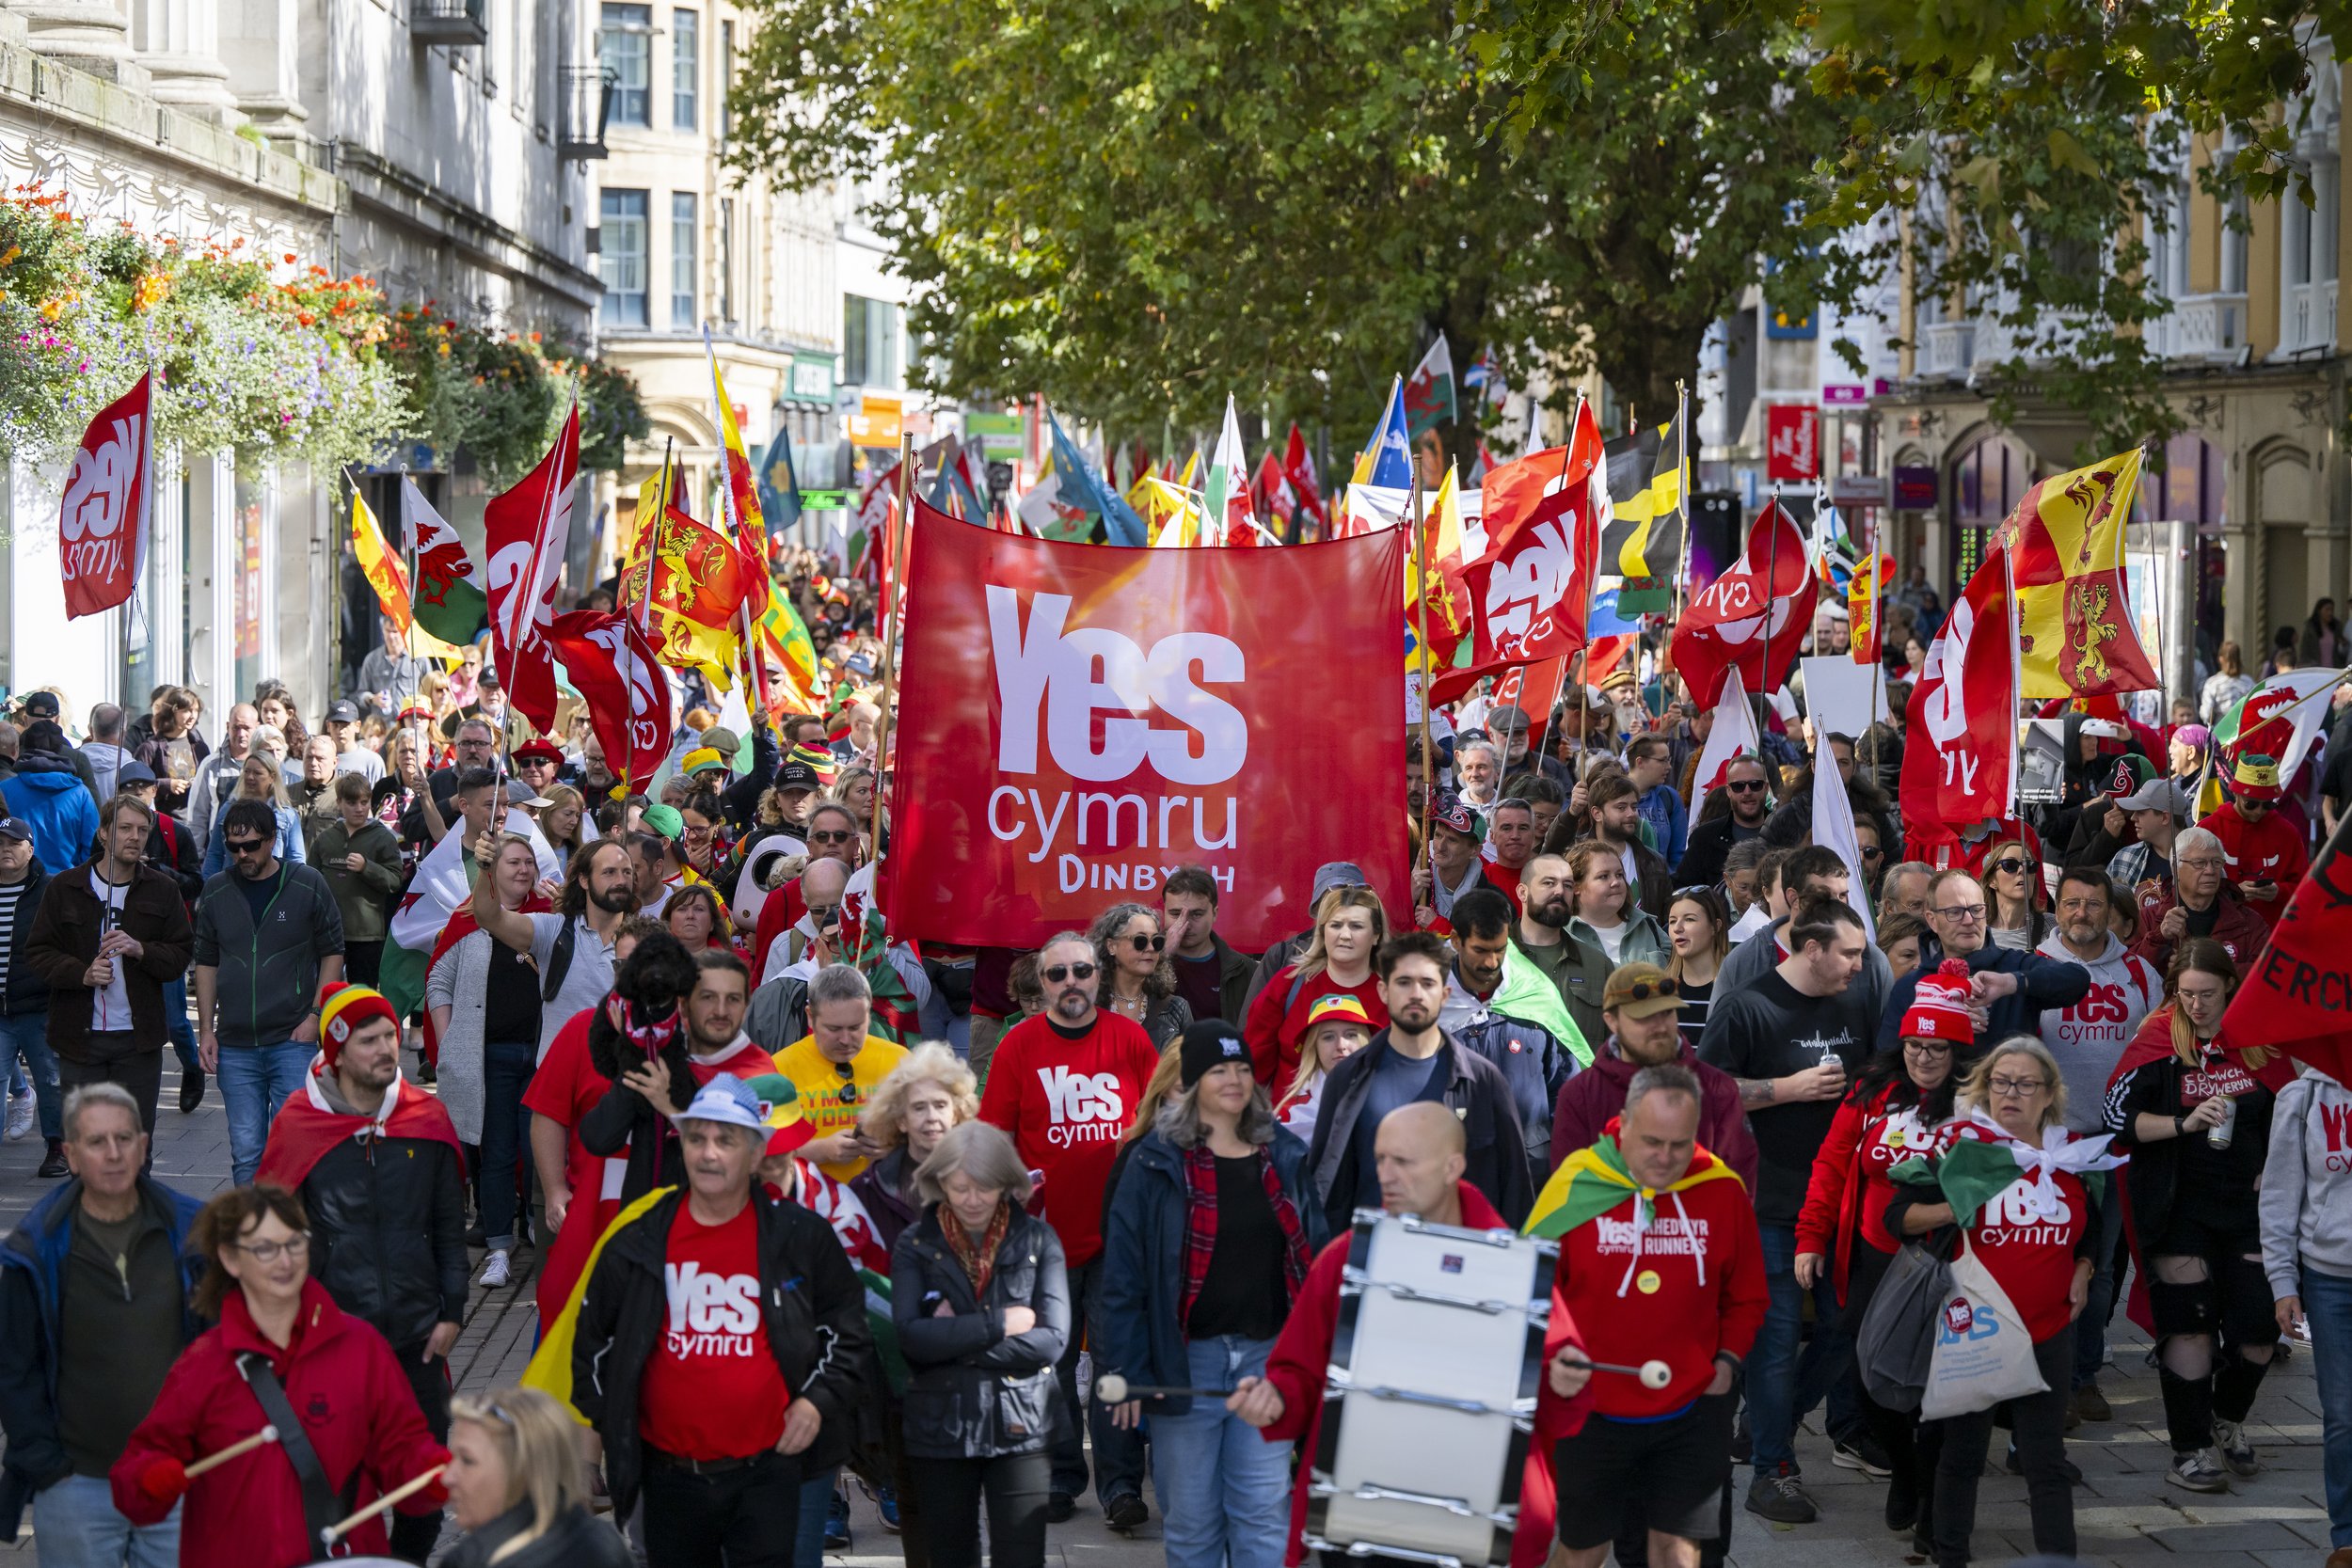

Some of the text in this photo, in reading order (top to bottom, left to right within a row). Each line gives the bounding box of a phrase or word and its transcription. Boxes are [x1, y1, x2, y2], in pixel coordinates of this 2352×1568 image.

[1772, 425, 1794, 458] Tim
[1791, 410, 1813, 474] Hortons
[985, 584, 1248, 785] Yes
[988, 784, 1237, 863] cymru
[1058, 853, 1235, 894] DINBYH
[1917, 1016, 1935, 1031] Yes
[2058, 1024, 2126, 1045] cymru
[1037, 1065, 1123, 1123] Yes
[2185, 1078, 2253, 1097] DRYWERYN
[1047, 1121, 1122, 1149] cymru
[1596, 1216, 1635, 1244] Yes
[1980, 1226, 2071, 1247] cymru
[1597, 1244, 1635, 1256] cymru
[664, 1260, 761, 1335] Yes
[1948, 1305, 1970, 1323] Yes
[667, 1331, 755, 1361] cymru
